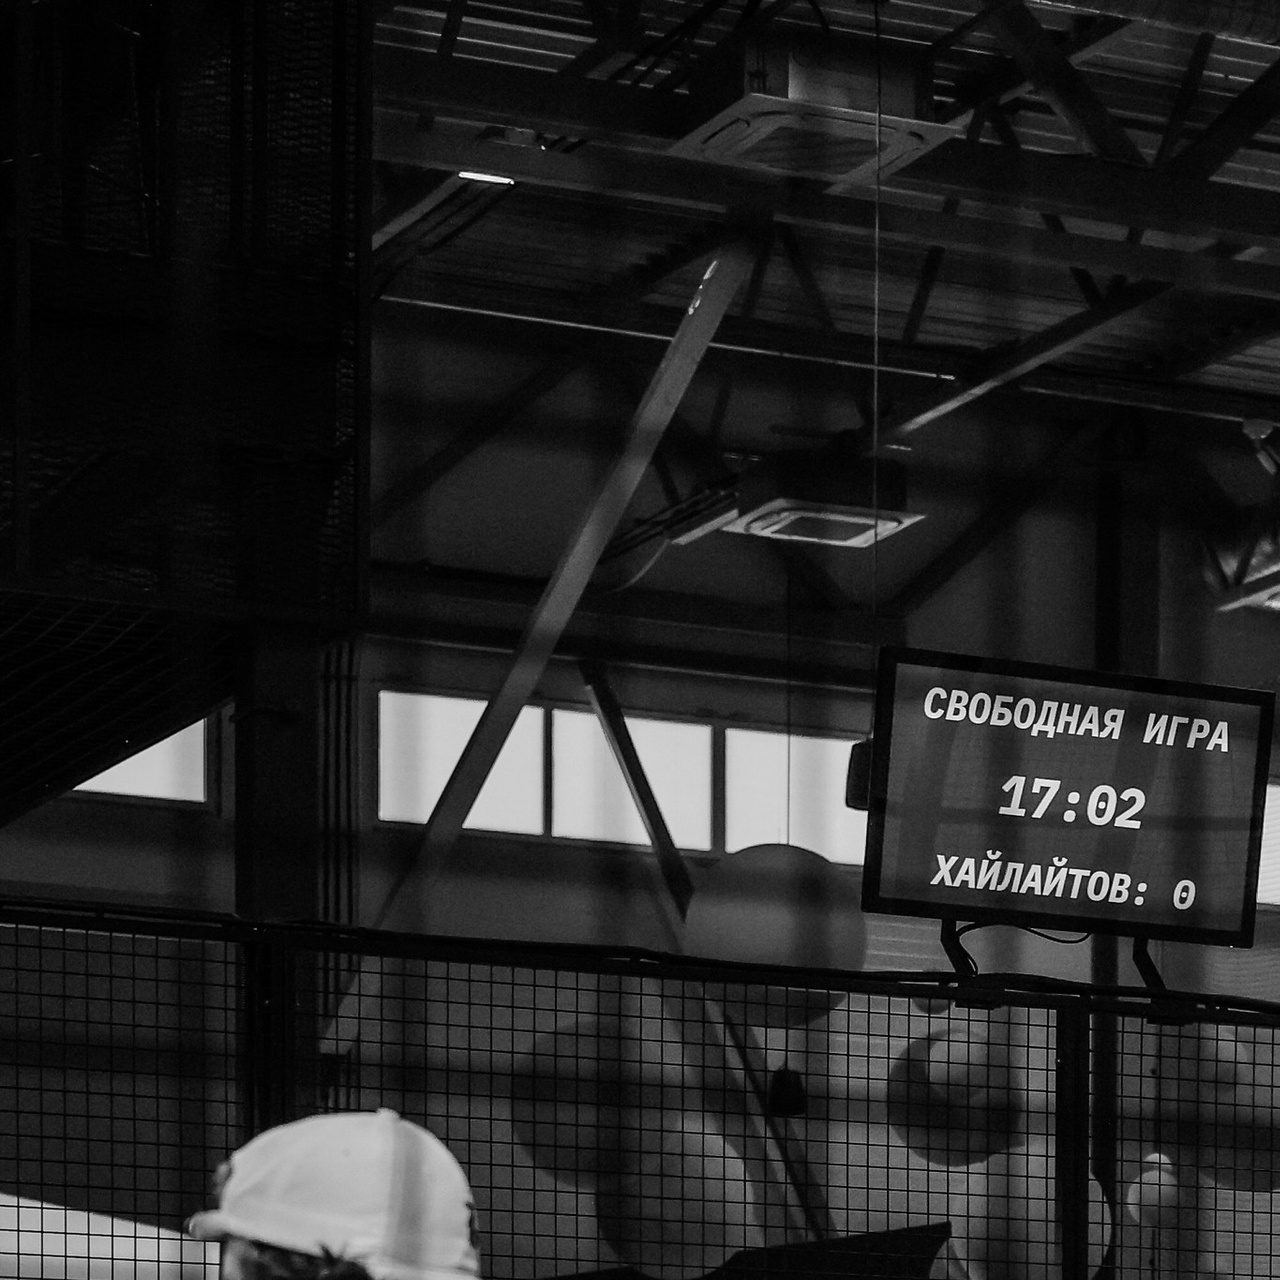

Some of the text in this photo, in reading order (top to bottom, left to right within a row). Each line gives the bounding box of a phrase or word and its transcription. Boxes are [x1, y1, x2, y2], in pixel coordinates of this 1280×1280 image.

[924, 686, 1230, 753] СВОБОДНАЯ ИГРА
[999, 775, 1146, 830] 17:02
[930, 849, 1197, 911] ХАЙЛАЙТОВ: 0
